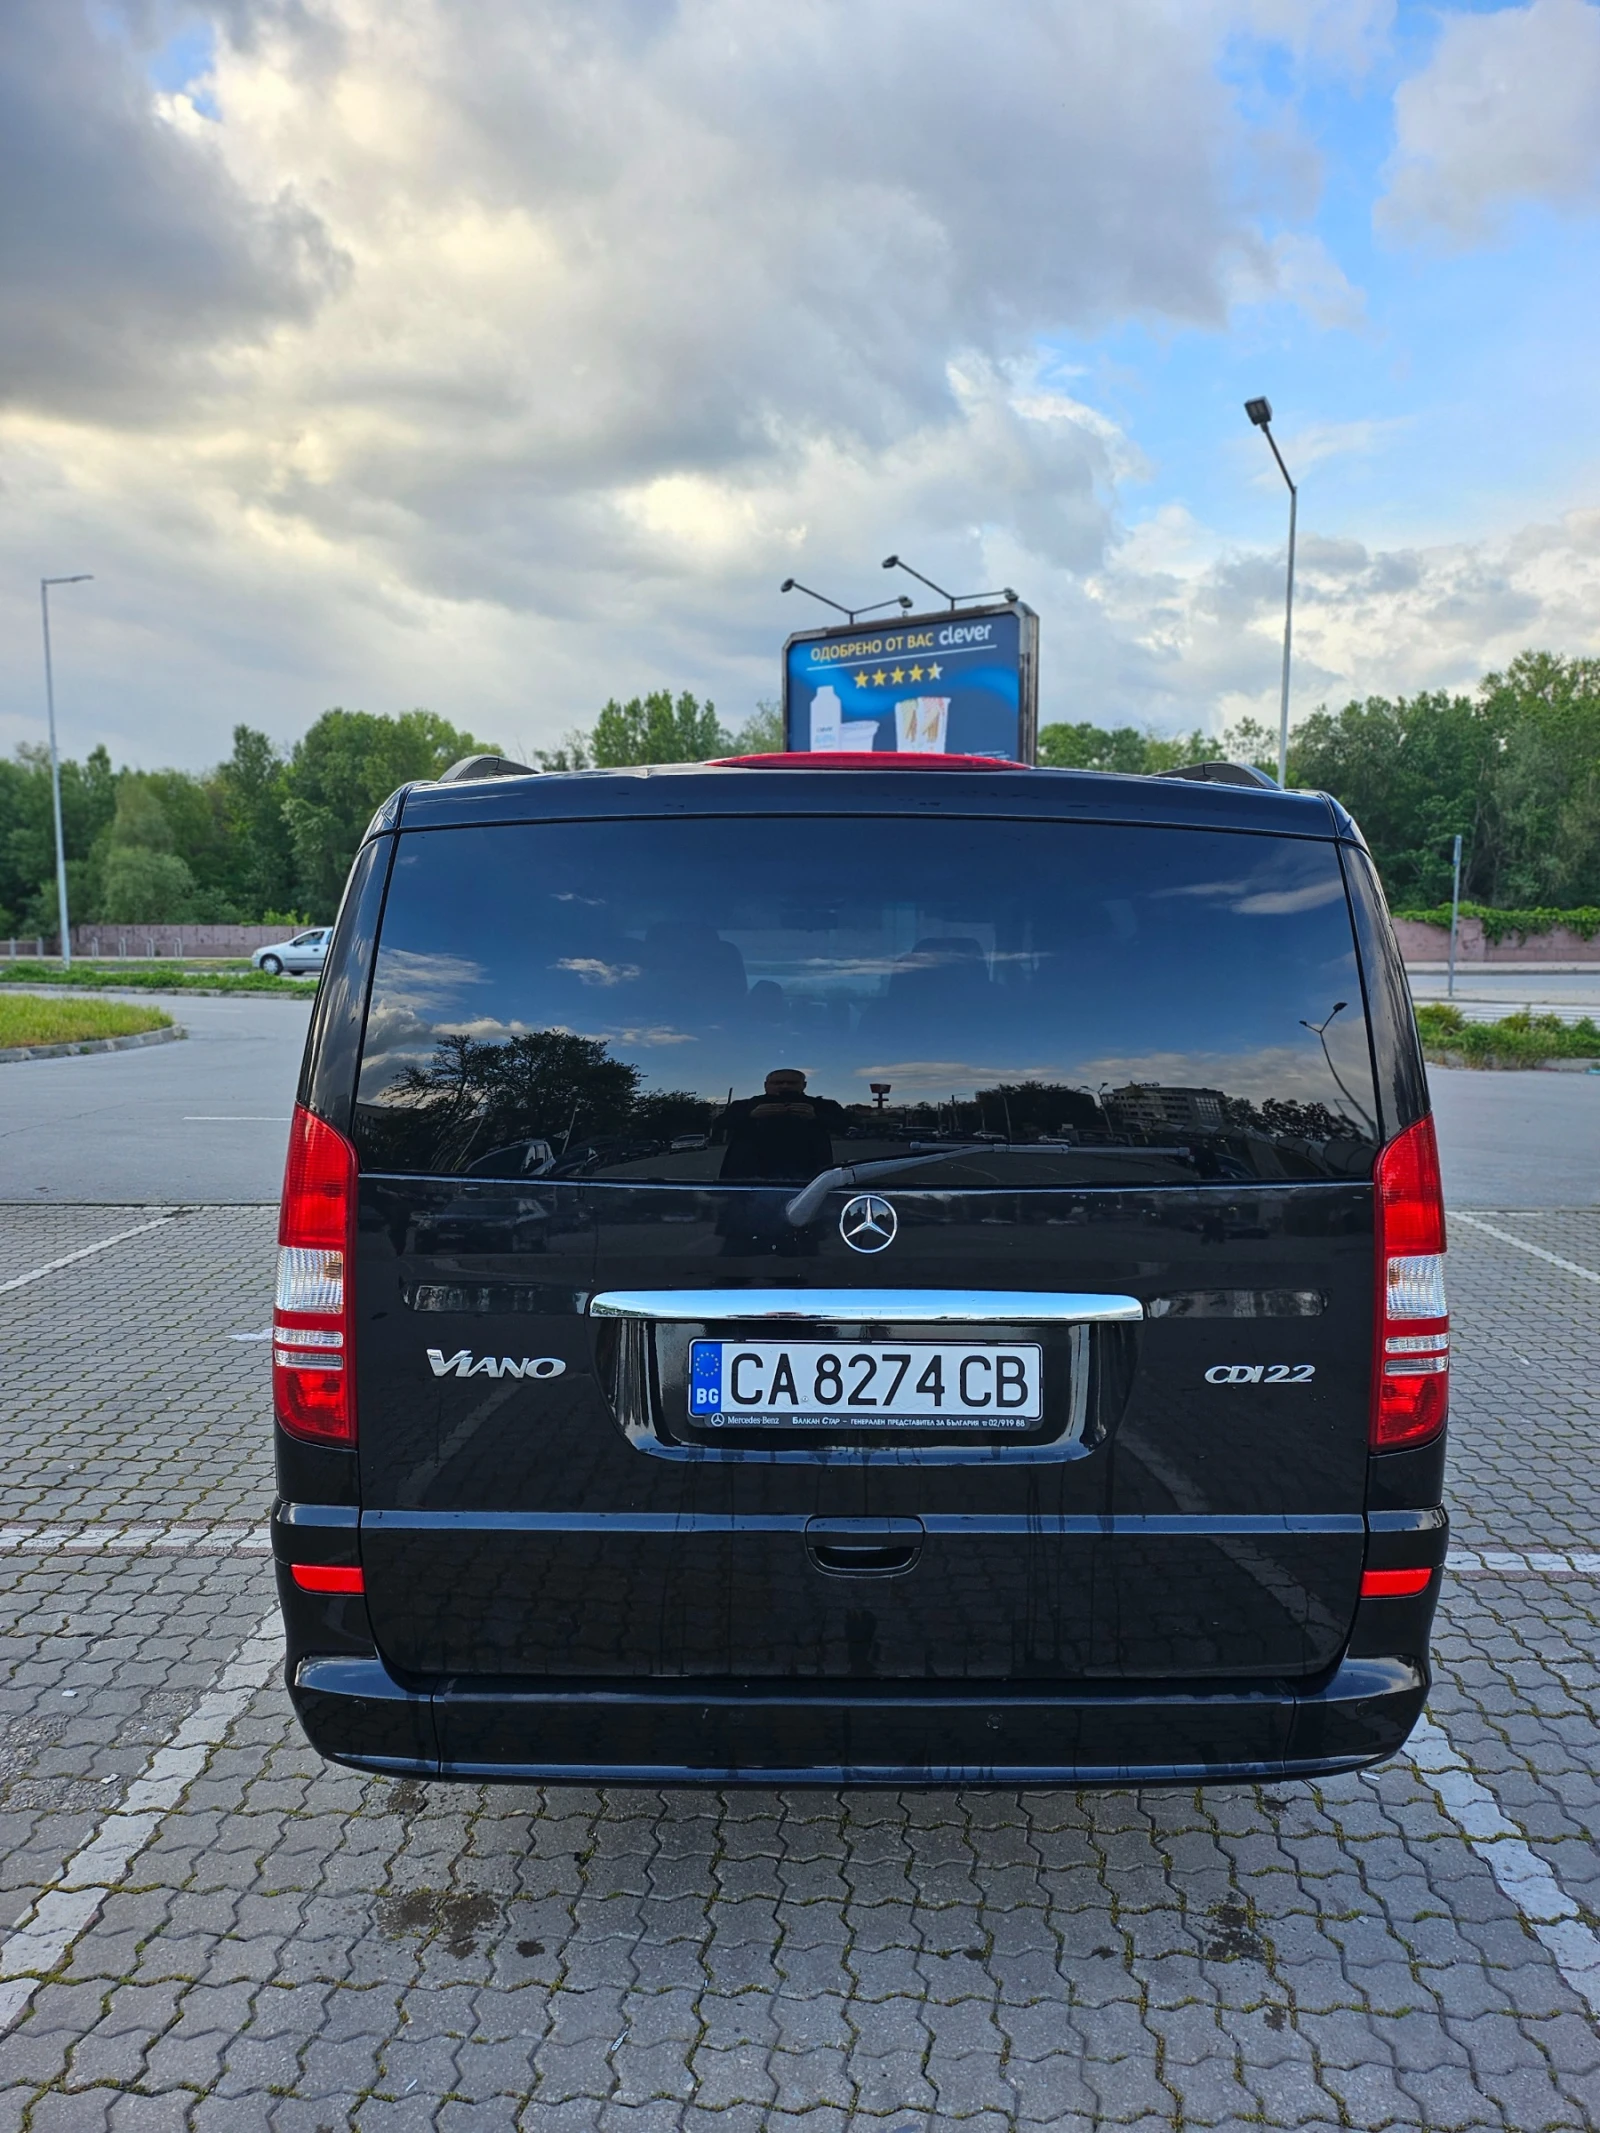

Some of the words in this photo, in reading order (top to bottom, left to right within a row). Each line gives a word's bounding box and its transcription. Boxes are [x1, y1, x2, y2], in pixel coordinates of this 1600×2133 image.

[811, 640, 882, 662] ОДОБРЕНО
[885, 636, 904, 651] ОТ
[907, 632, 934, 648] ВАС
[939, 624, 992, 645] clever
[426, 1349, 567, 1379] VIANO
[731, 1353, 799, 1405] CA
[814, 1354, 945, 1406] 8274
[959, 1355, 1028, 1408] CB
[1204, 1365, 1264, 1384] CDI
[696, 1388, 719, 1404] BG
[727, 1416, 780, 1425] Mercedes-Benz
[851, 1418, 885, 1426] ГЕНЕРАЛЕН
[887, 1418, 935, 1427] ПРЕДСТАВИТЕЛ
